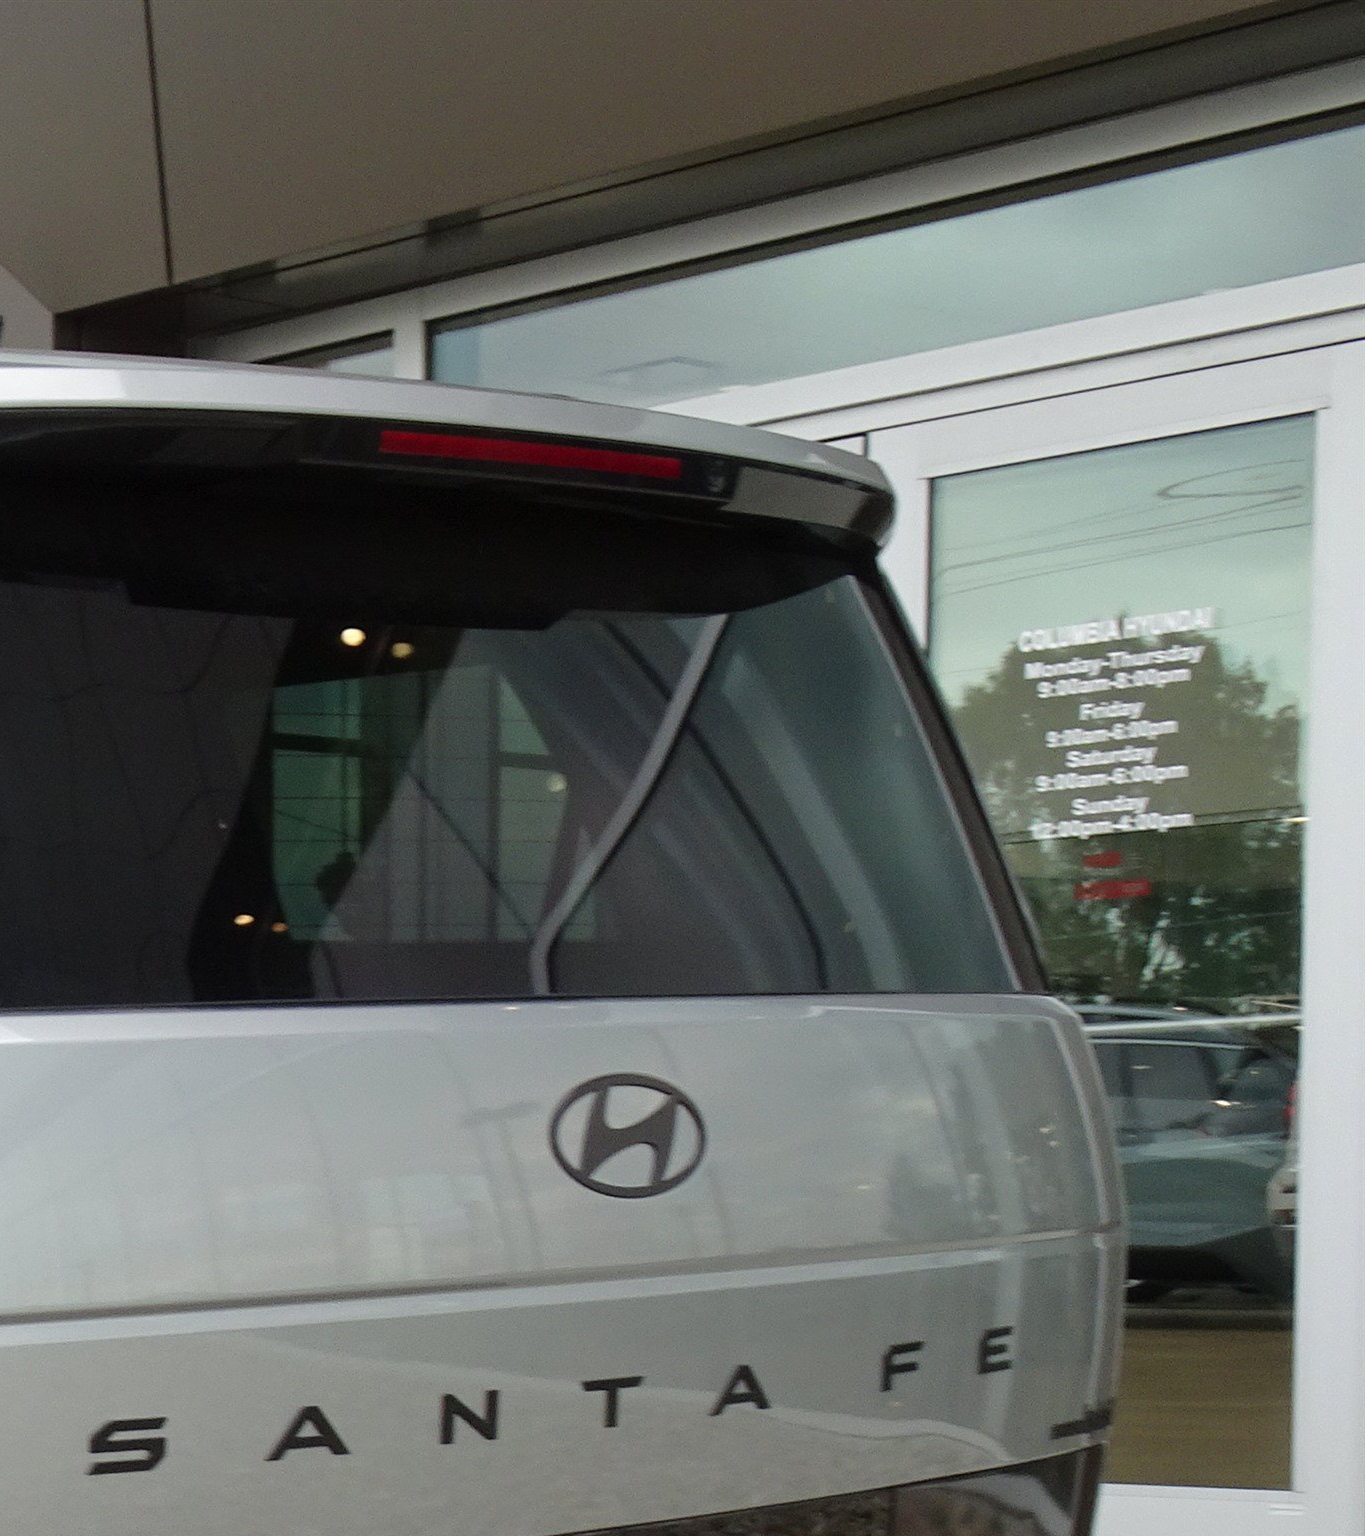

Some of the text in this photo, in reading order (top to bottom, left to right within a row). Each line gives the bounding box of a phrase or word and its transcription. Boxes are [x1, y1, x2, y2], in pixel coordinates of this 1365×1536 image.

[1024, 645, 1206, 680] Monday-Thursday
[1079, 701, 1145, 720] Friday
[1065, 745, 1158, 768] Saturday
[1071, 795, 1150, 815] Sunday
[84, 1326, 1013, 1476] SANTA FE
